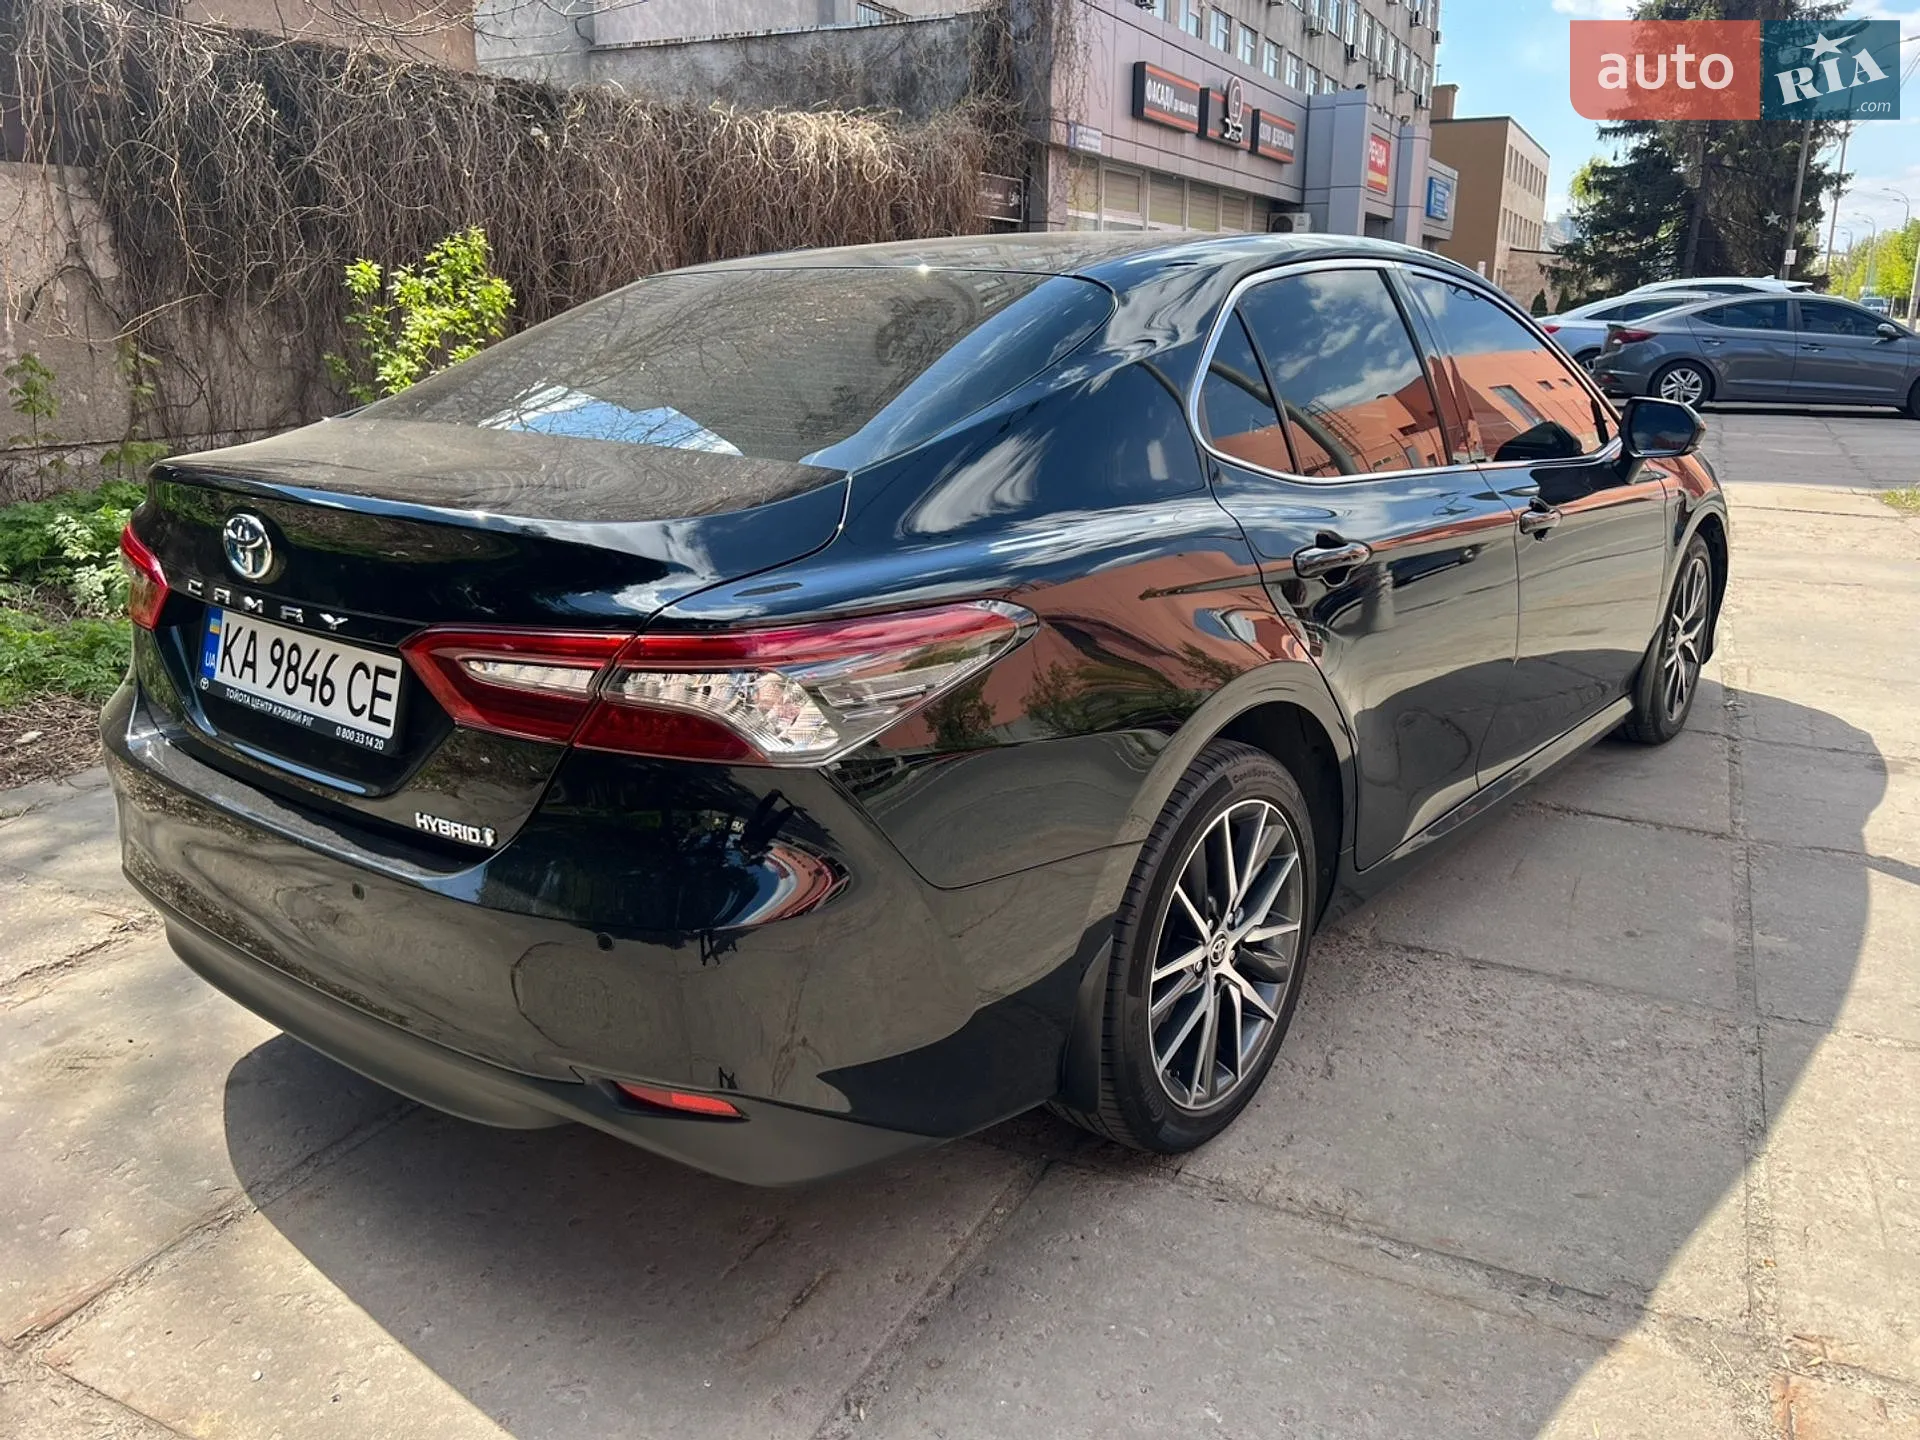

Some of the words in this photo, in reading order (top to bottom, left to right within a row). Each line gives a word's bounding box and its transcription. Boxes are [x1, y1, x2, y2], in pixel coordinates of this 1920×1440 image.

[187, 578, 349, 630] CAMRY
[205, 651, 216, 669] UA
[220, 622, 257, 684] KA
[266, 638, 340, 707] 9846
[346, 661, 397, 727] CE
[226, 687, 251, 705] ТОЙОТА
[251, 697, 273, 711] ЦЕНТР
[272, 704, 302, 723] КРИВИЙ
[335, 725, 341, 737] 0
[341, 727, 355, 741] 800
[354, 732, 365, 744] 33
[365, 735, 374, 747] 14
[374, 738, 385, 750] 20
[415, 812, 481, 844] HYBRID
